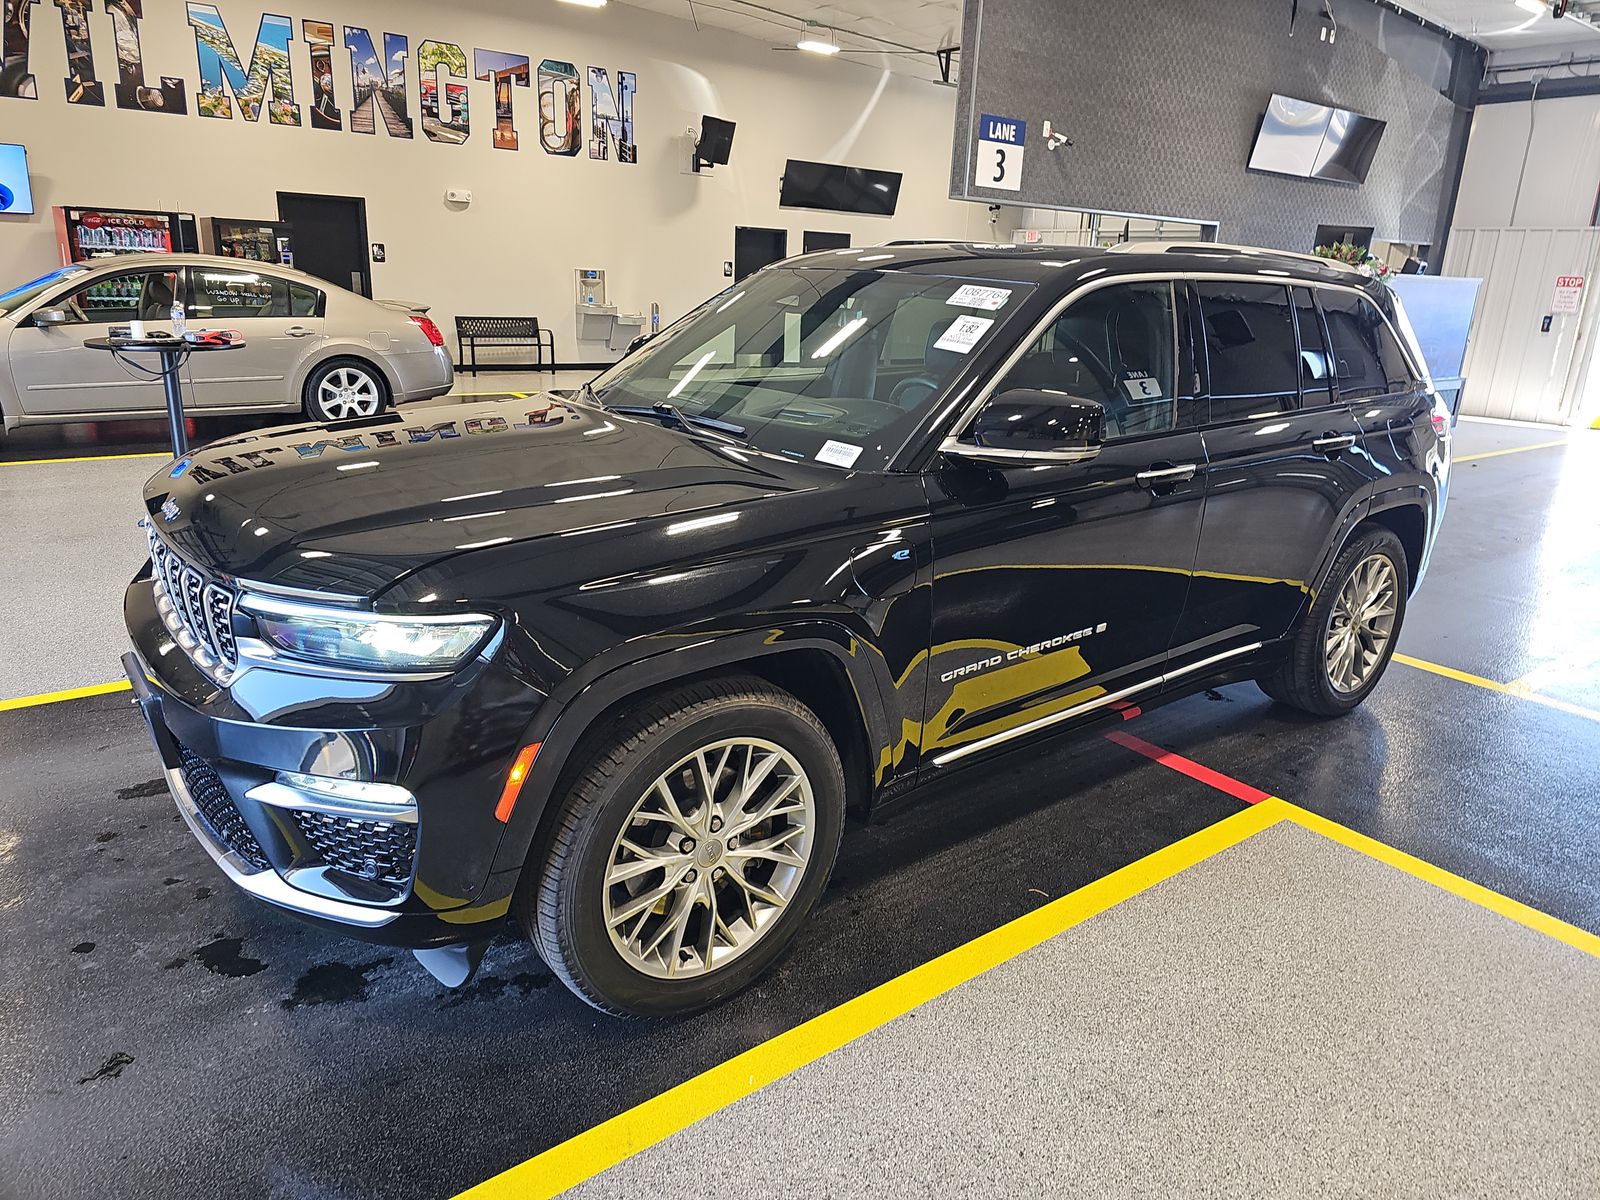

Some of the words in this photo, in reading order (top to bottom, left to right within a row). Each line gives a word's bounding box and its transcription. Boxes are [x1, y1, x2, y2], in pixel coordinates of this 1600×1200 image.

[989, 121, 1016, 141] LANE
[993, 149, 1006, 182] 3
[123, 218, 145, 226] COLD
[1557, 277, 1583, 287] STOP
[940, 655, 1003, 683] GRAND
[1006, 626, 1094, 662] CHEROKEE
